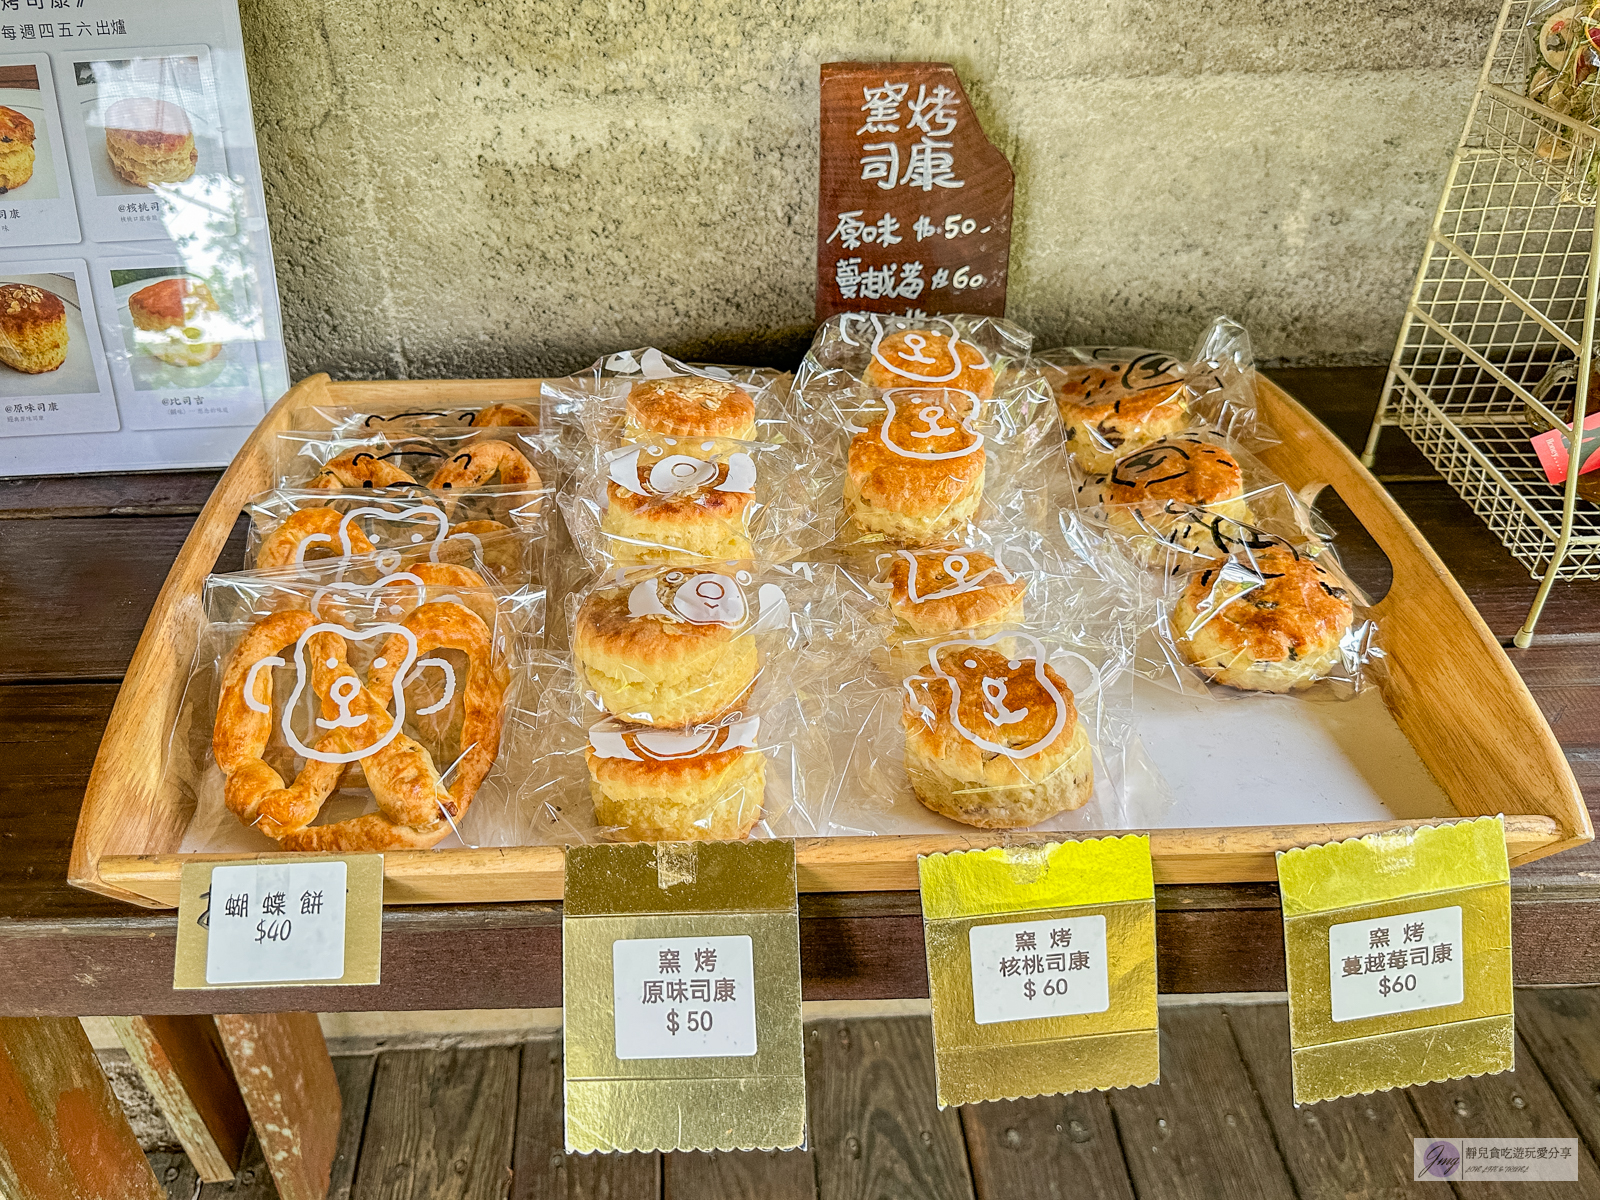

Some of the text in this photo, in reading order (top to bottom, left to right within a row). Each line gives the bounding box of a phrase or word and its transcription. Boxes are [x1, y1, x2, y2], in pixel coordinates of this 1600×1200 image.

[1, 19, 127, 40] 每週四五六出爐
[856, 81, 961, 136] 窯烤
[859, 136, 965, 191] 司康
[826, 210, 902, 250] 原味
[4, 402, 59, 413] @原味司康
[161, 395, 205, 406] @比司吉
[224, 889, 324, 918] 蝴蝶餅
[254, 918, 292, 944] $40
[999, 950, 1091, 978] 核桃司康
[1341, 942, 1453, 978] 蔓越莓司康
[641, 976, 737, 1005] 原味司康
[1378, 973, 1417, 998] $60
